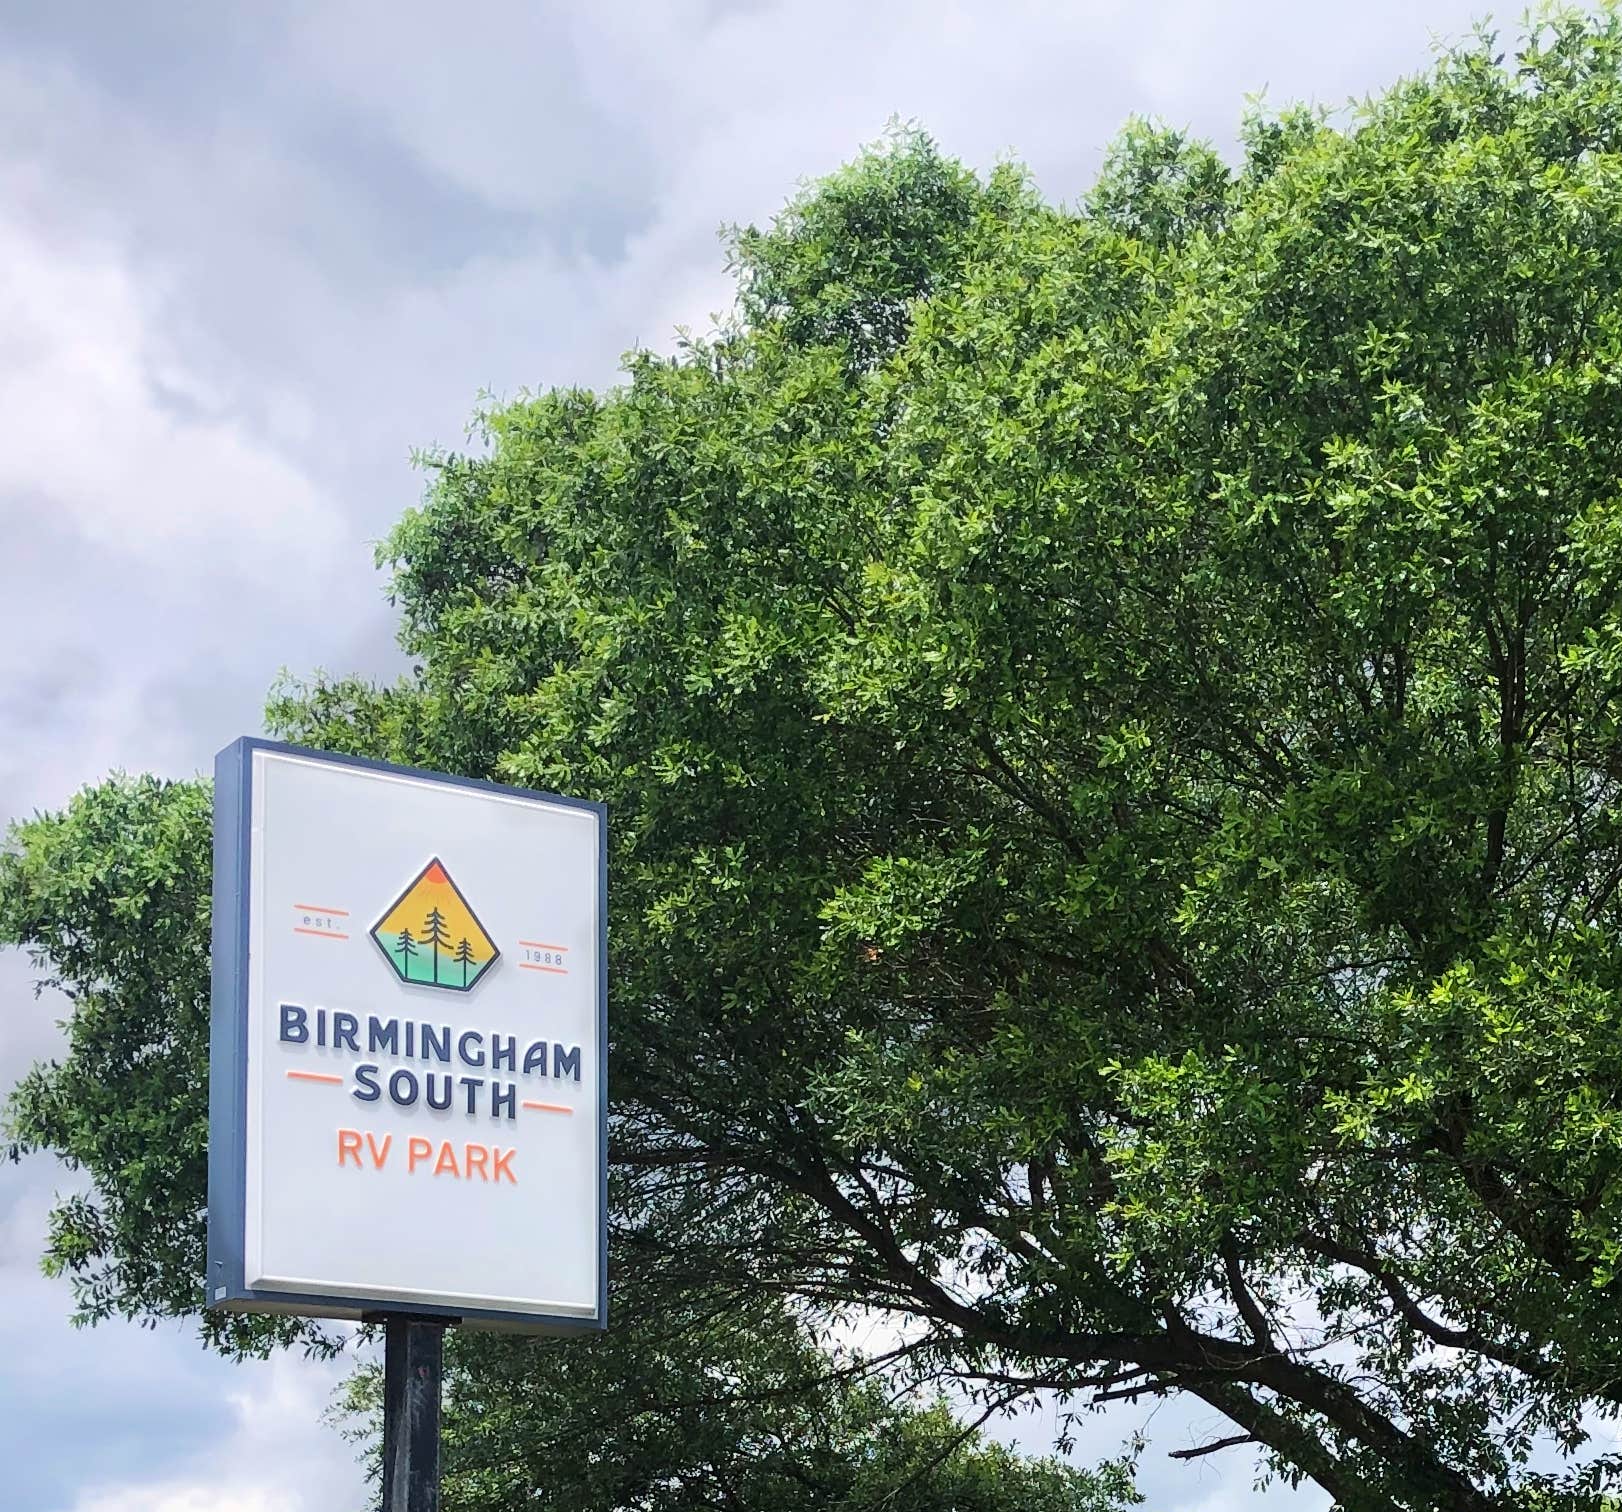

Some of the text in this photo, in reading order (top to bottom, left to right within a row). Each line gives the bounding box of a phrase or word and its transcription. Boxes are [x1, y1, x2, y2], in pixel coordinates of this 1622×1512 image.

[303, 916, 341, 931] est.
[525, 949, 563, 966] 1988
[279, 1004, 582, 1082] BIRMINGHAM
[353, 1063, 516, 1120] SOUTH
[337, 1128, 518, 1184] RV PARK
